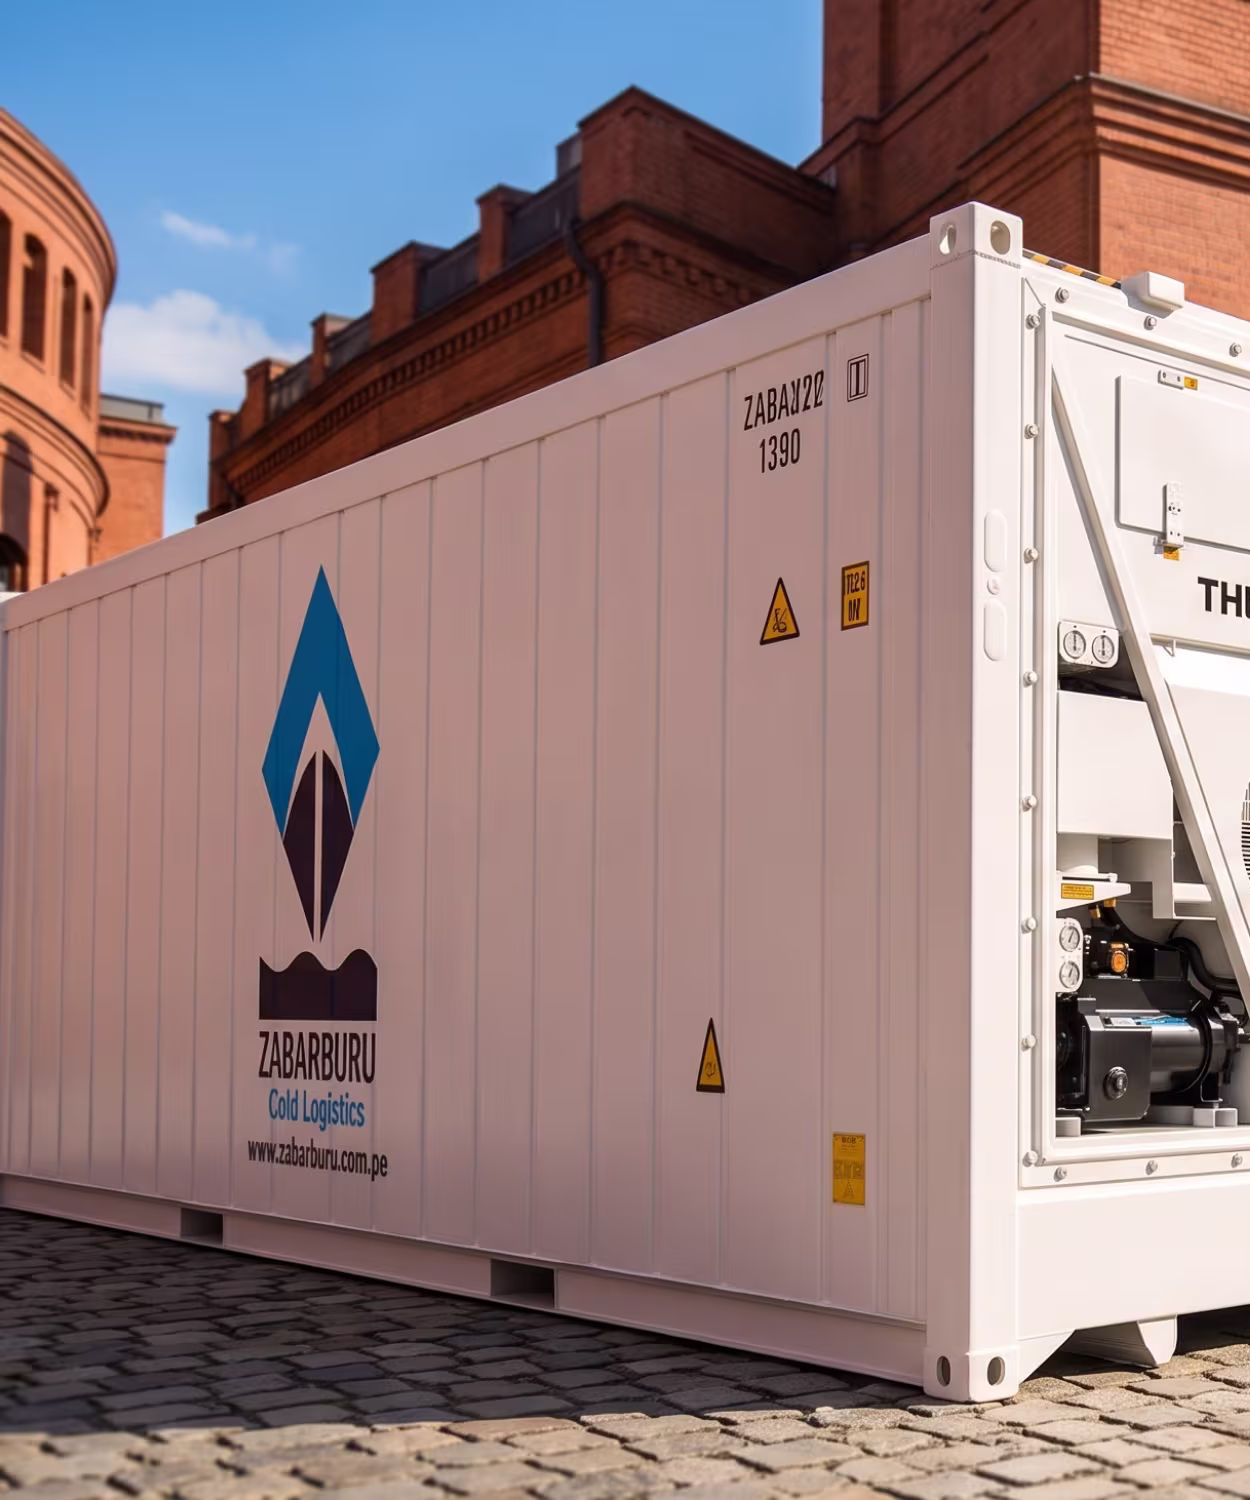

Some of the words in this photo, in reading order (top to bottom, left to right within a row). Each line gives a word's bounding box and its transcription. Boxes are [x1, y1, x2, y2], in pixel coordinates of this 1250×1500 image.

[759, 428, 801, 474] 1390
[258, 1030, 377, 1084] ZABARBURU
[268, 1087, 299, 1122] Cold
[302, 1089, 366, 1132] Logistics
[247, 1136, 388, 1182] www.zabarburu.com.pe
